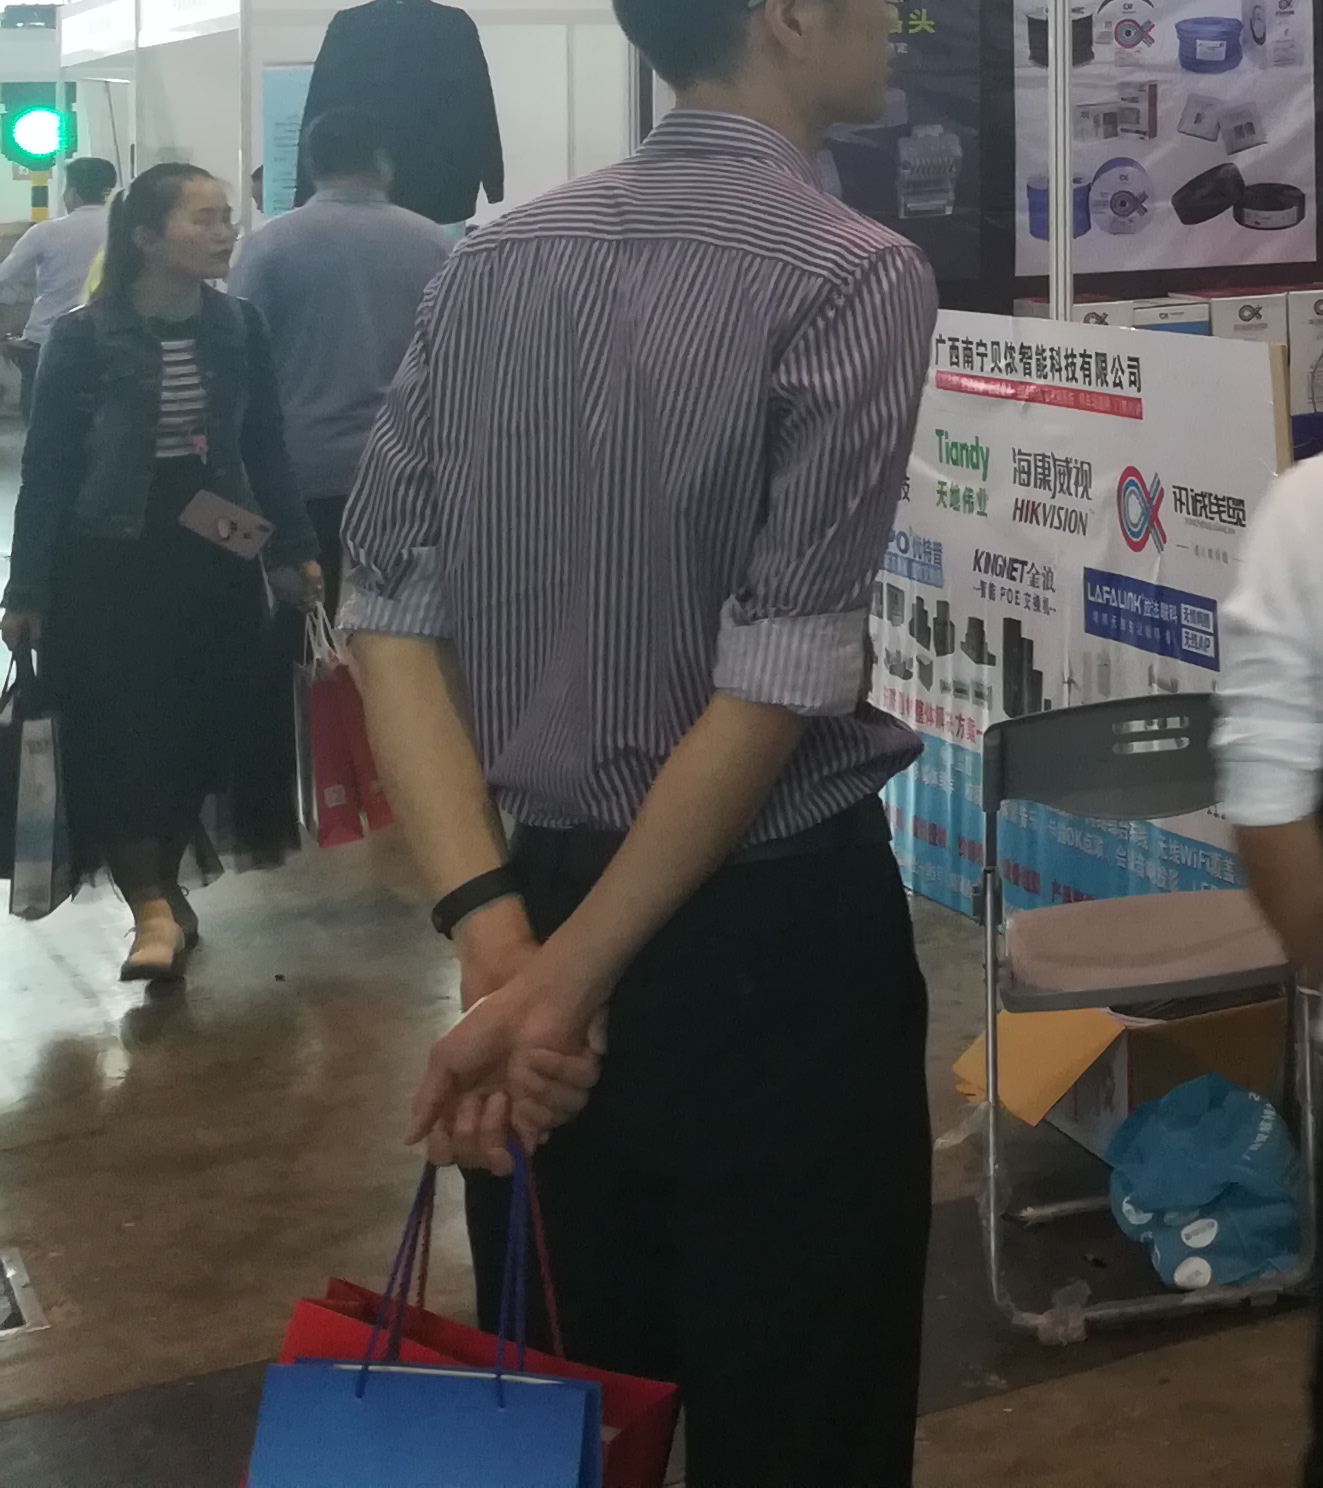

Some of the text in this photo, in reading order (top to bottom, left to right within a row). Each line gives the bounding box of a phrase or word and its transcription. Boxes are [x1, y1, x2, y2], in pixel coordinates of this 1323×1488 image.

[935, 428, 990, 482] Tiandy
[1011, 447, 1093, 501] 海康威视
[1012, 497, 1089, 537] HIKVISION
